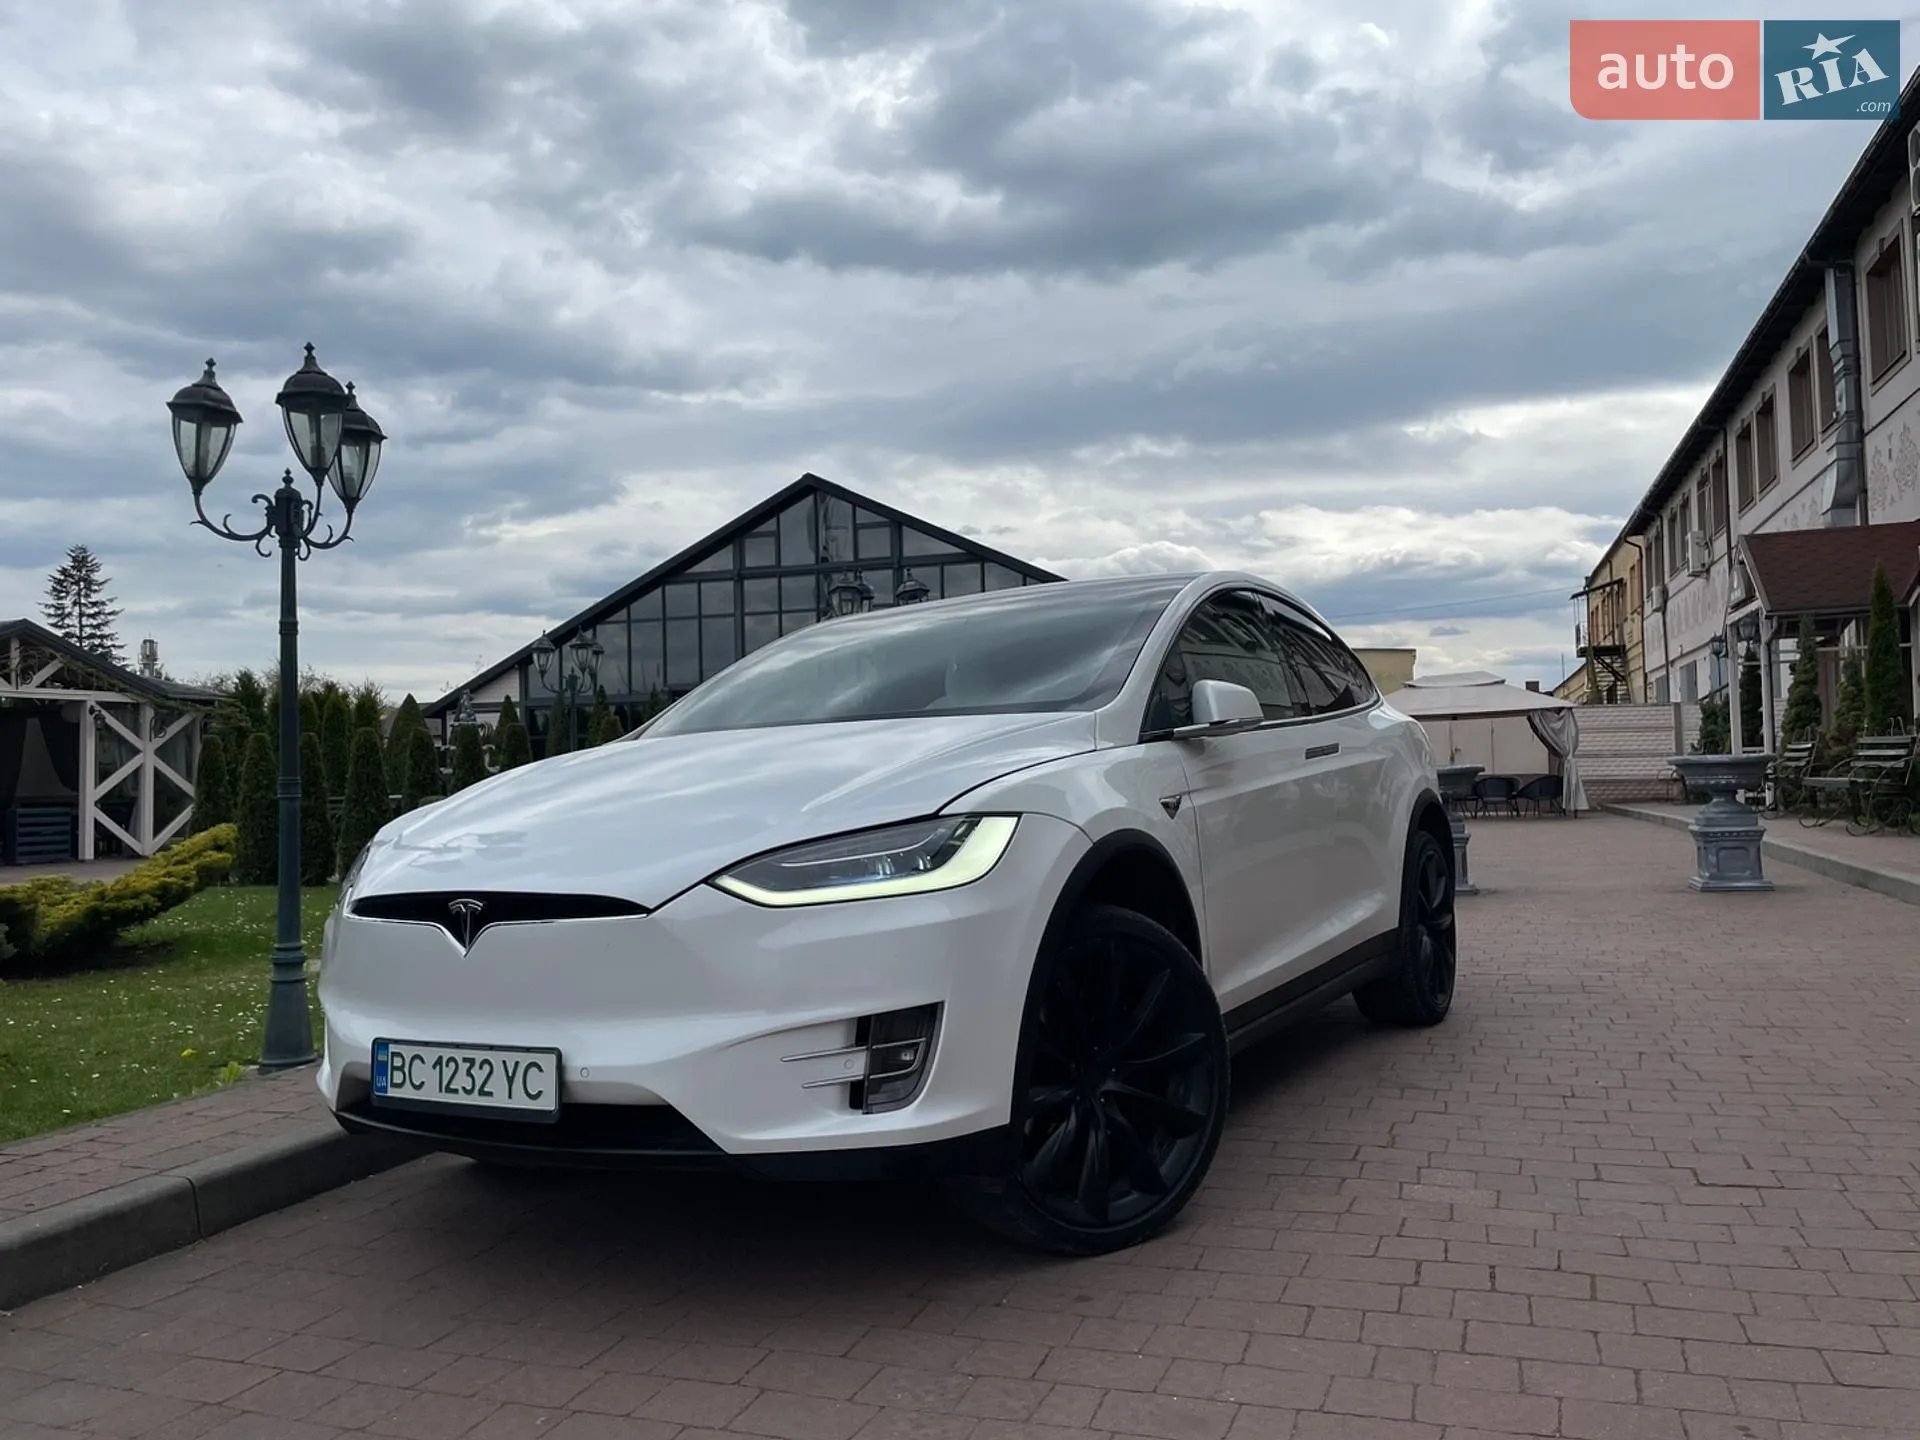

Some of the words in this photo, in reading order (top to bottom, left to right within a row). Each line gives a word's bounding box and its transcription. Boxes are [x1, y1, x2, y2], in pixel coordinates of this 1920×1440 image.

[376, 1075, 387, 1087] UA
[390, 1051, 426, 1091] BC
[432, 1054, 494, 1097] 1232
[502, 1059, 544, 1101] YC
